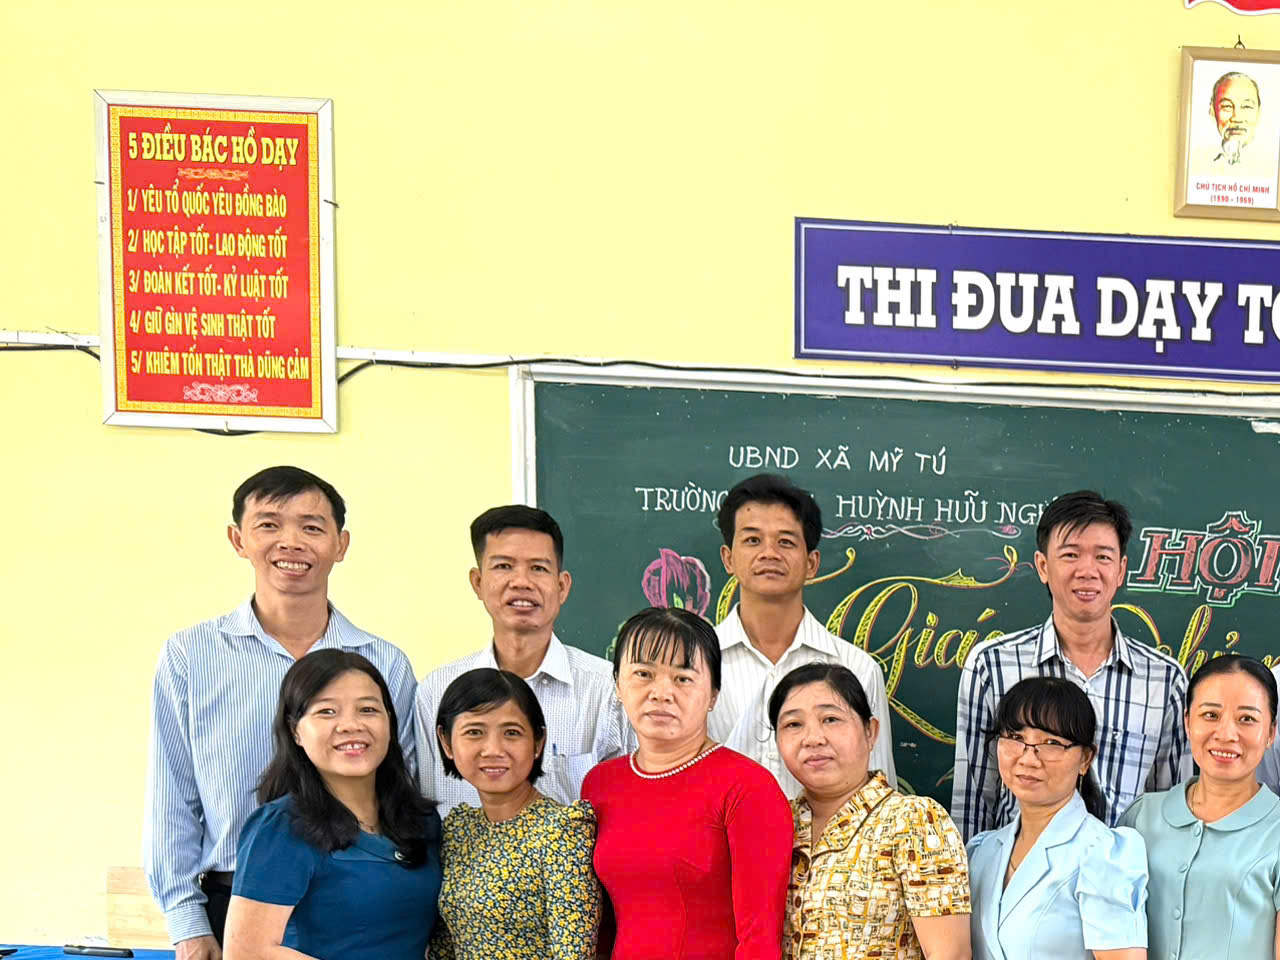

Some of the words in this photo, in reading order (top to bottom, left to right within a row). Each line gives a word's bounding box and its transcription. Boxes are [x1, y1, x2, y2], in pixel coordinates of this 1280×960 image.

[128, 132, 138, 159] 5
[141, 122, 186, 162] ĐIỀU
[190, 127, 228, 163] BÁC
[231, 126, 258, 164] HỒ
[261, 137, 299, 171] DẠY
[127, 188, 138, 212] 1/
[141, 183, 163, 214] YÊU
[165, 178, 179, 214] TỔ
[181, 182, 210, 218] QUỐC
[212, 186, 233, 216] YÊU
[235, 183, 263, 217] ĐỒNG
[265, 188, 287, 218] BÀO
[127, 229, 140, 252] 2/
[143, 229, 165, 258] HỌC
[166, 225, 187, 259] TẬP
[215, 233, 236, 256] LAO
[238, 227, 266, 261] ĐỘNG
[268, 226, 288, 258] TỐT
[128, 269, 140, 293] 3/
[143, 265, 172, 294] ĐOÀN
[175, 264, 195, 295] KẾT
[223, 265, 238, 297] KỶ
[240, 268, 266, 302] LUẬT
[268, 266, 288, 298] TỐT
[129, 310, 141, 334] 4/
[144, 306, 163, 335] GIỮ
[165, 306, 182, 336] GÌN
[184, 306, 198, 341] VỆ
[200, 313, 225, 337] SINH
[226, 308, 254, 342] THẬT
[255, 306, 276, 339] TỐT
[837, 264, 937, 329] THI
[951, 269, 1081, 335] ĐUA
[1096, 276, 1224, 354] DẠY
[131, 350, 142, 373] 5/
[146, 345, 180, 375] KHIÊM
[182, 344, 203, 376] TỐN
[205, 348, 232, 381] THẬT
[233, 349, 255, 378] THÀ
[257, 350, 285, 379] DŨNG
[287, 348, 309, 380] CẢM
[728, 446, 800, 469] UBND
[815, 445, 851, 470] XÃ
[868, 447, 904, 472] MỸ
[914, 446, 946, 475] TÚ
[835, 488, 925, 521] HUỲNH
[934, 489, 989, 524] HỮU
